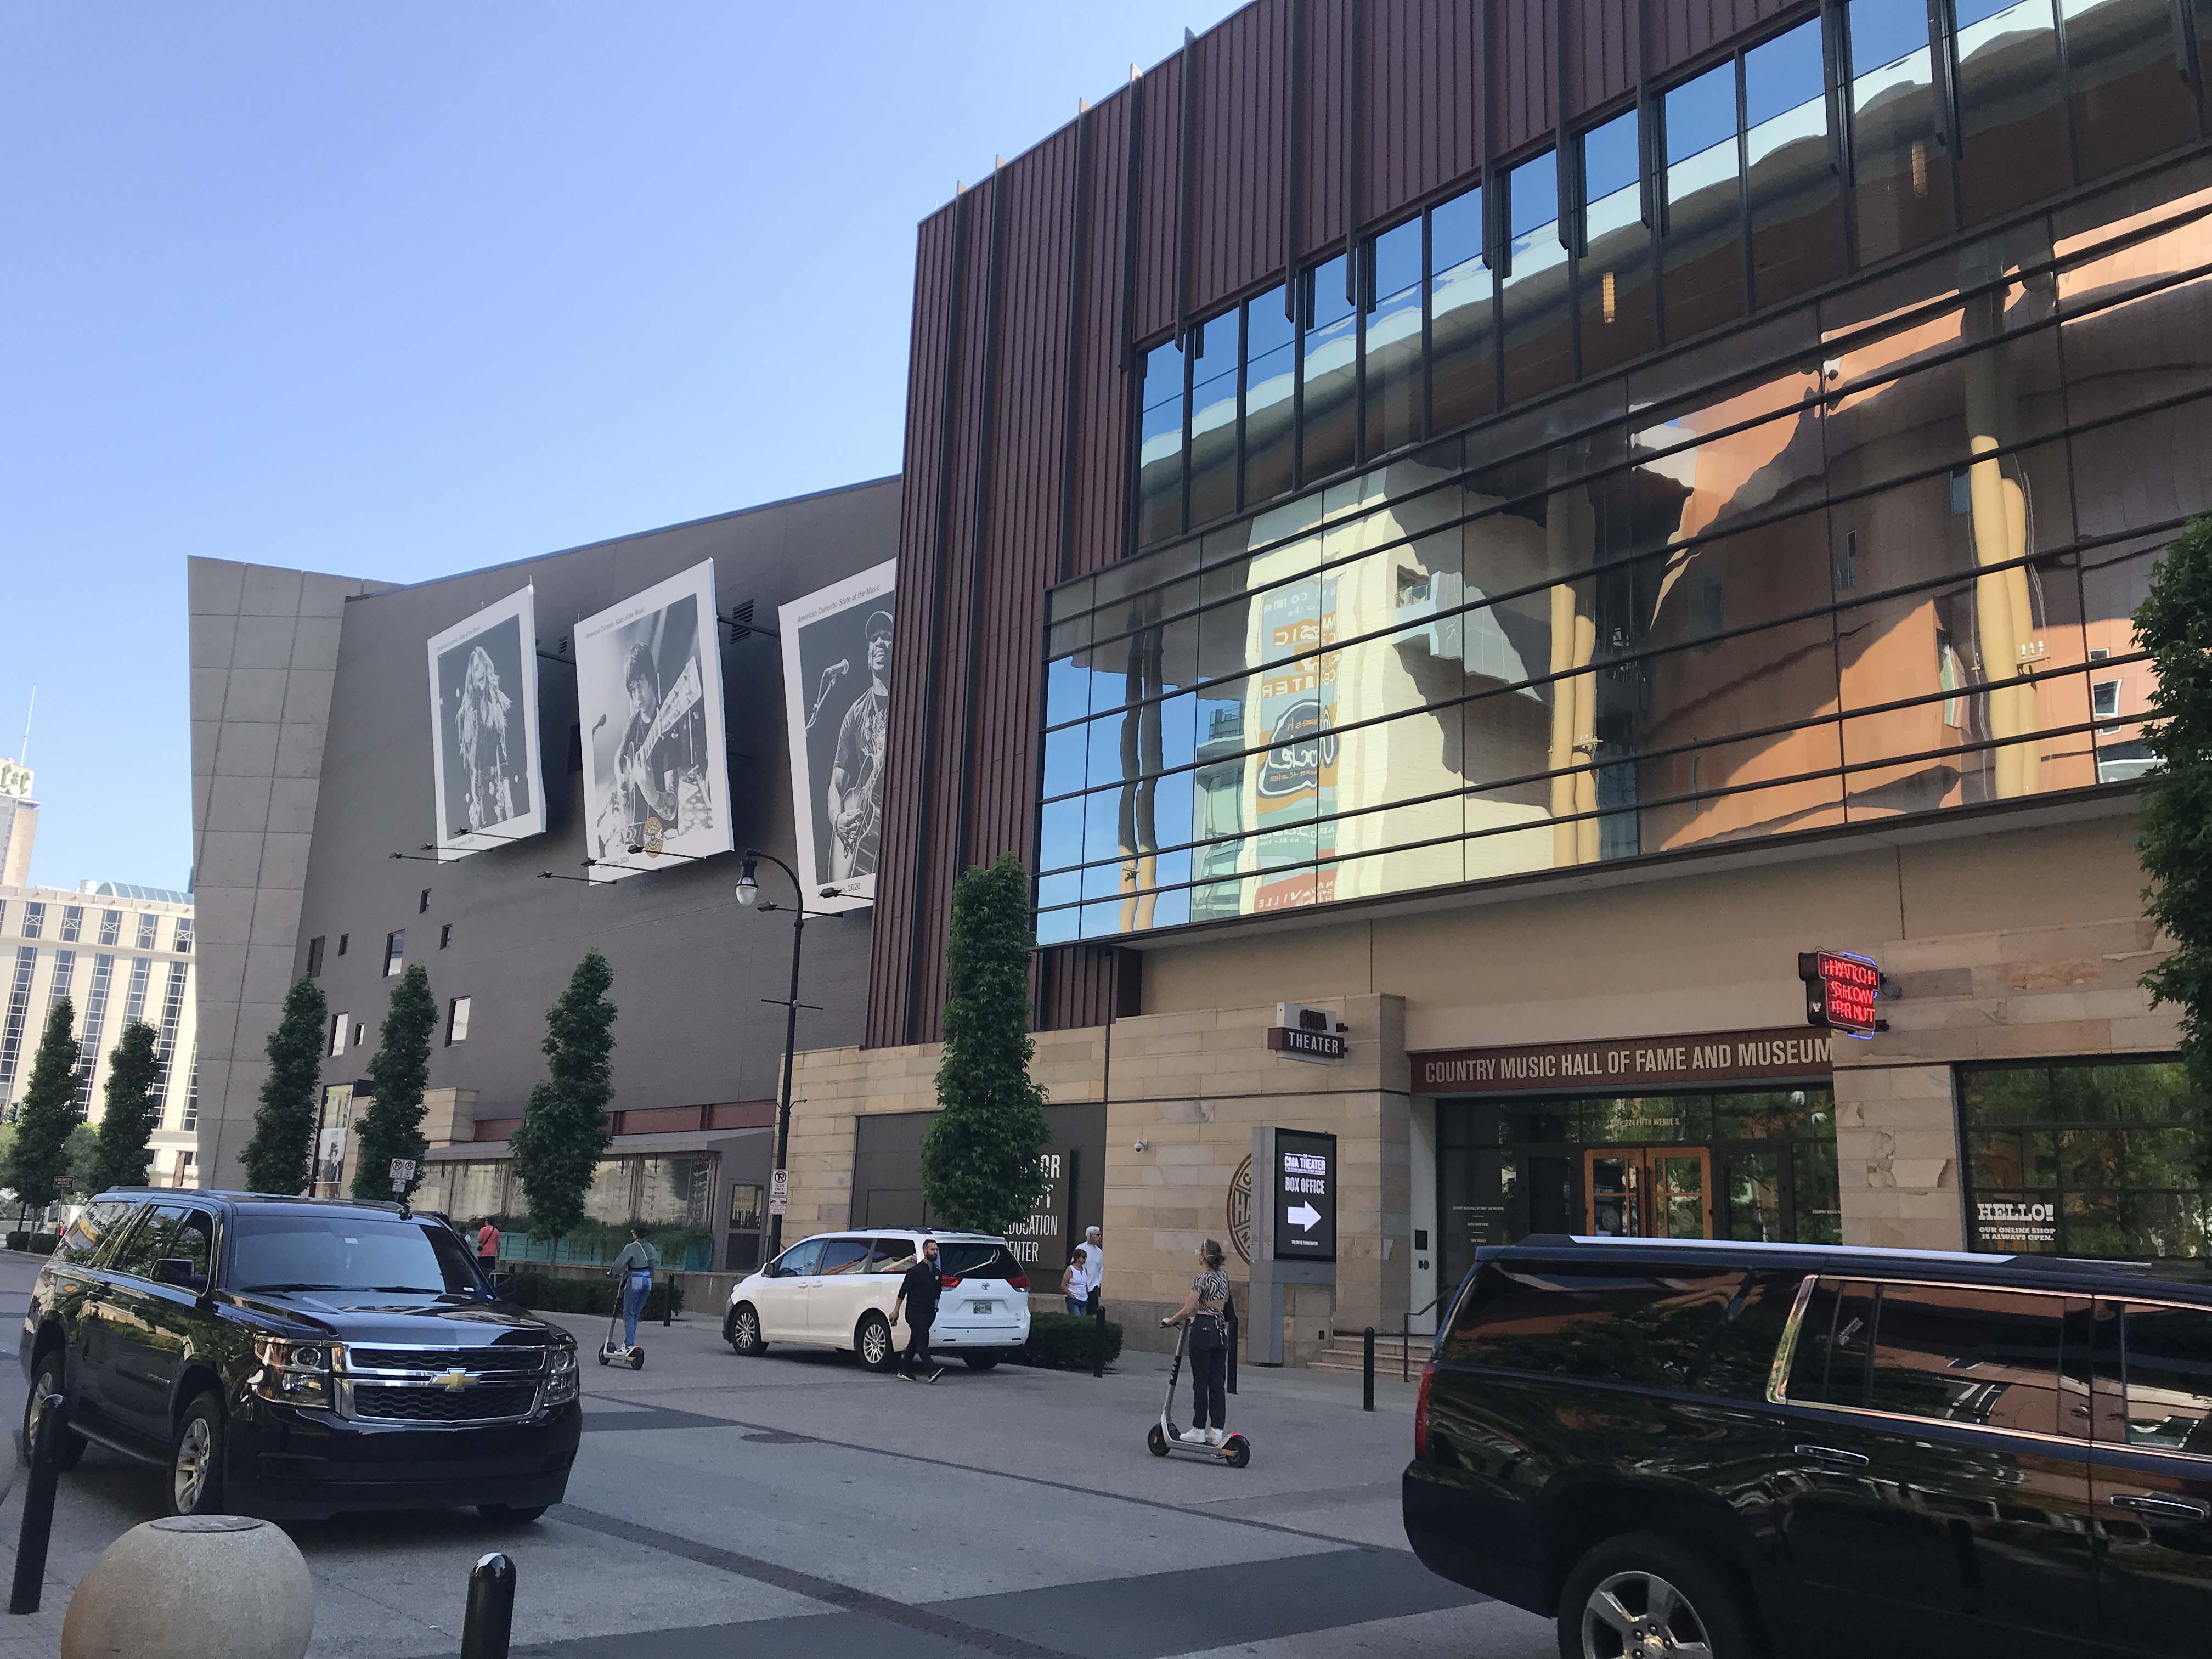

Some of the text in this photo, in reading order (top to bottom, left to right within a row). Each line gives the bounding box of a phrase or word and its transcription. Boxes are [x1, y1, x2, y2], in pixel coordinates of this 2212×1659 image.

[797, 611, 817, 623] American
[839, 597, 852, 606] State
[866, 584, 881, 595] Music
[848, 882, 861, 891] 2020
[1826, 959, 1876, 986] HATCH
[1833, 981, 1874, 1005] SHOW
[1289, 1032, 1339, 1054] THEATER
[1426, 1037, 1832, 1083] COUNTRY MUSIC HALL OF FAME AND MUSEUM
[1284, 1156, 1299, 1168] CMA
[1300, 1158, 1325, 1171] THEATER
[1285, 1176, 1325, 1194] BOX OFFICE
[1977, 1203, 2054, 1221] HELLO!
